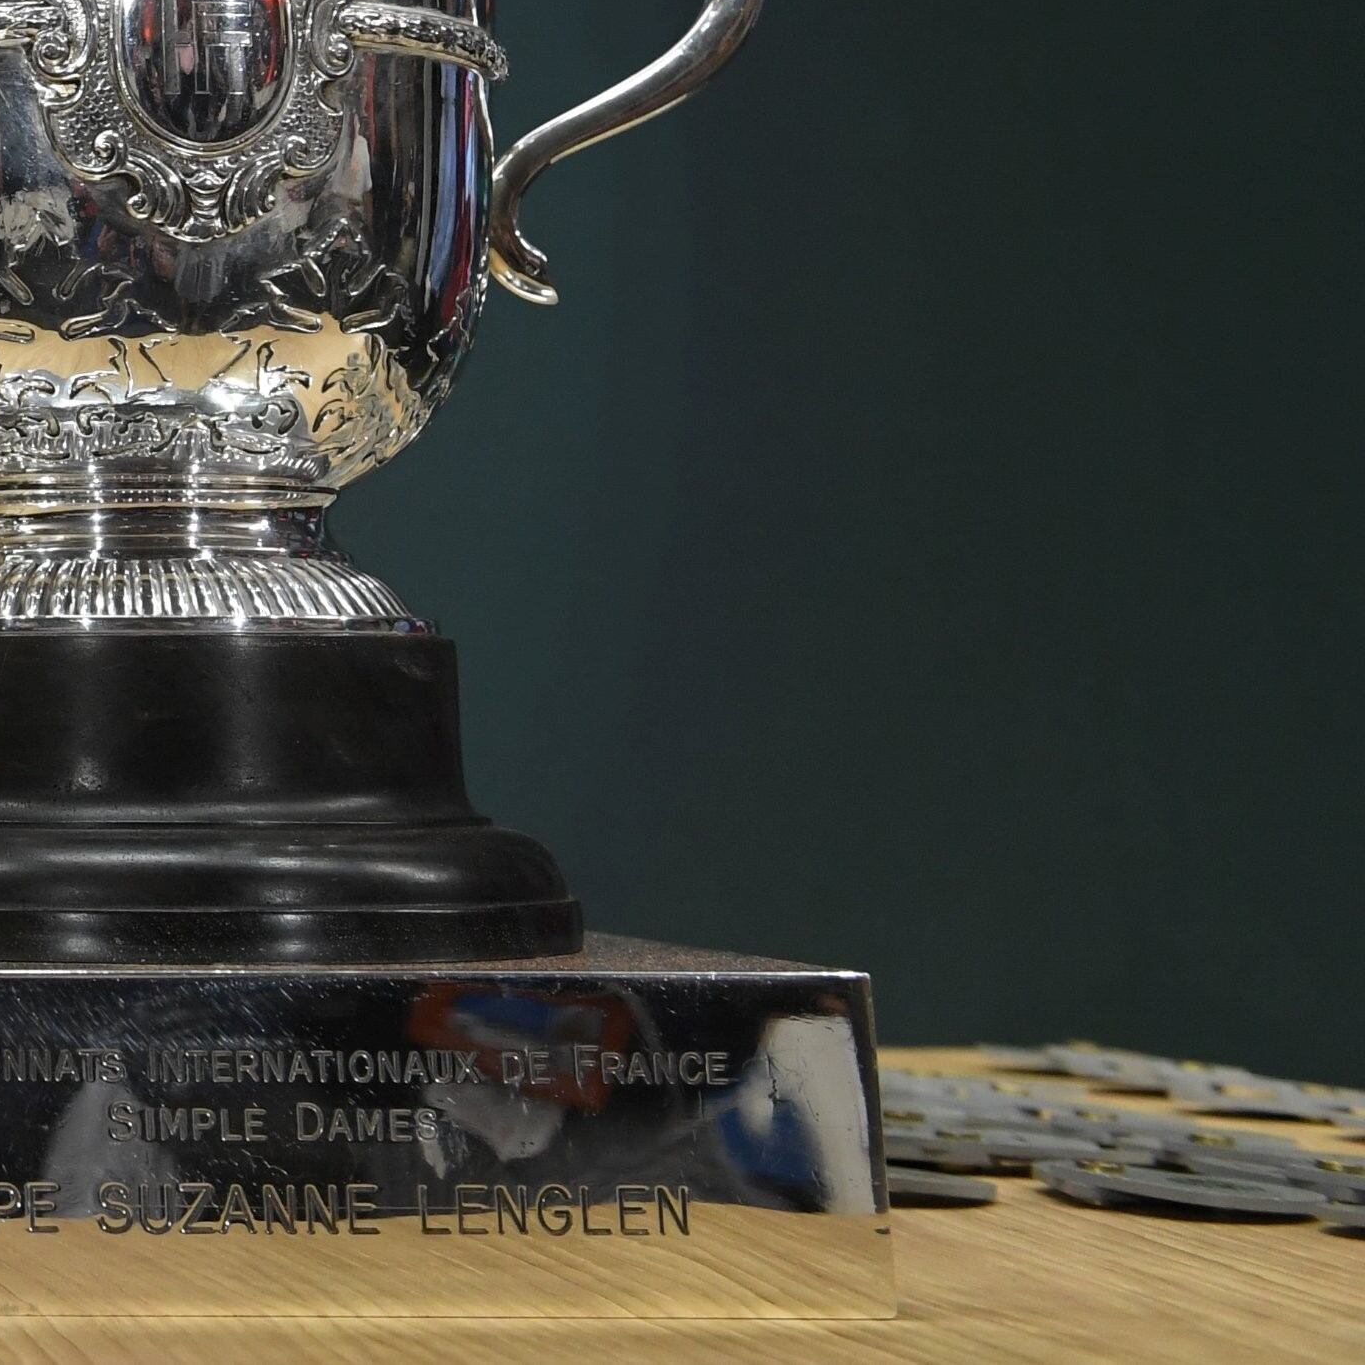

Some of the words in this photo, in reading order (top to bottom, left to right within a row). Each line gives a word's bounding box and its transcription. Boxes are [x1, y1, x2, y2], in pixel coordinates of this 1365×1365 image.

[502, 1047, 553, 1086] DE
[572, 1042, 731, 1087] FRANCE
[107, 1101, 269, 1144] SIMPLE
[295, 1101, 439, 1144] DAMES
[97, 1181, 380, 1236] SUZANNE
[418, 1183, 693, 1238] LENGLEN
